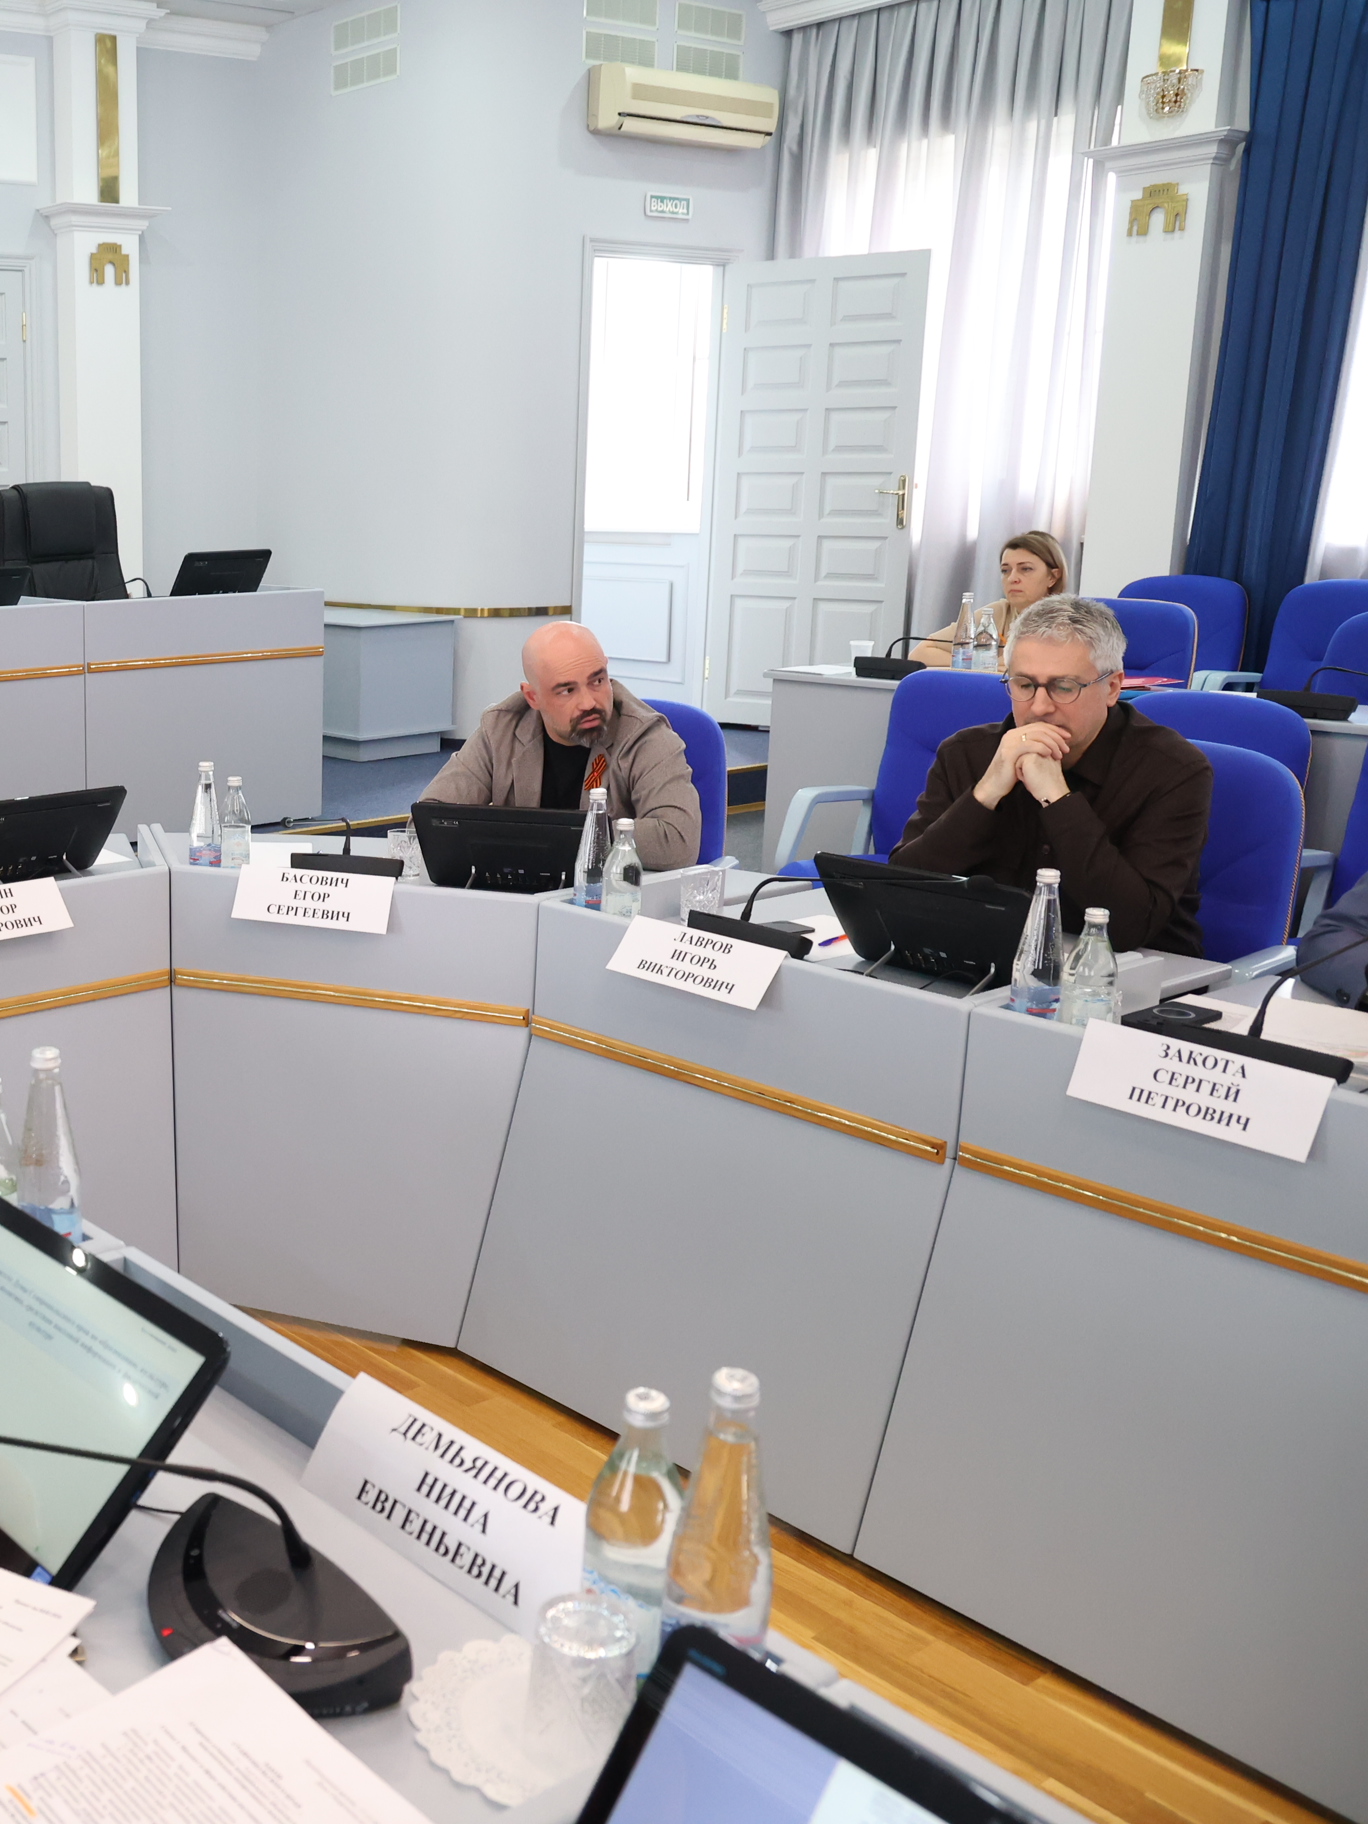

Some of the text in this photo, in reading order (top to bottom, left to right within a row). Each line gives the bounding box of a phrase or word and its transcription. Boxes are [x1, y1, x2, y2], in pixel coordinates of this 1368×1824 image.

[651, 198, 688, 214] ВЫХОД
[281, 872, 350, 889] БАСОВИЧ
[293, 890, 331, 903] ЕГОР
[266, 903, 351, 922] СЕРГЕЕВИЧ
[670, 949, 717, 971] ИГОРЬ
[673, 931, 733, 955] ЛАВРОВ
[636, 959, 736, 995] ВИКТОРОВИЧ
[1158, 1043, 1248, 1079] ЗАКОТА
[1152, 1068, 1242, 1104] СЕРГЕЙ
[1127, 1086, 1251, 1133] ПЕТРОВИЧ
[390, 1413, 562, 1528] ДЕМЬЯНОВА
[415, 1470, 491, 1535] НИНА
[355, 1478, 522, 1608] ЕВГЕНЬЕВНА
